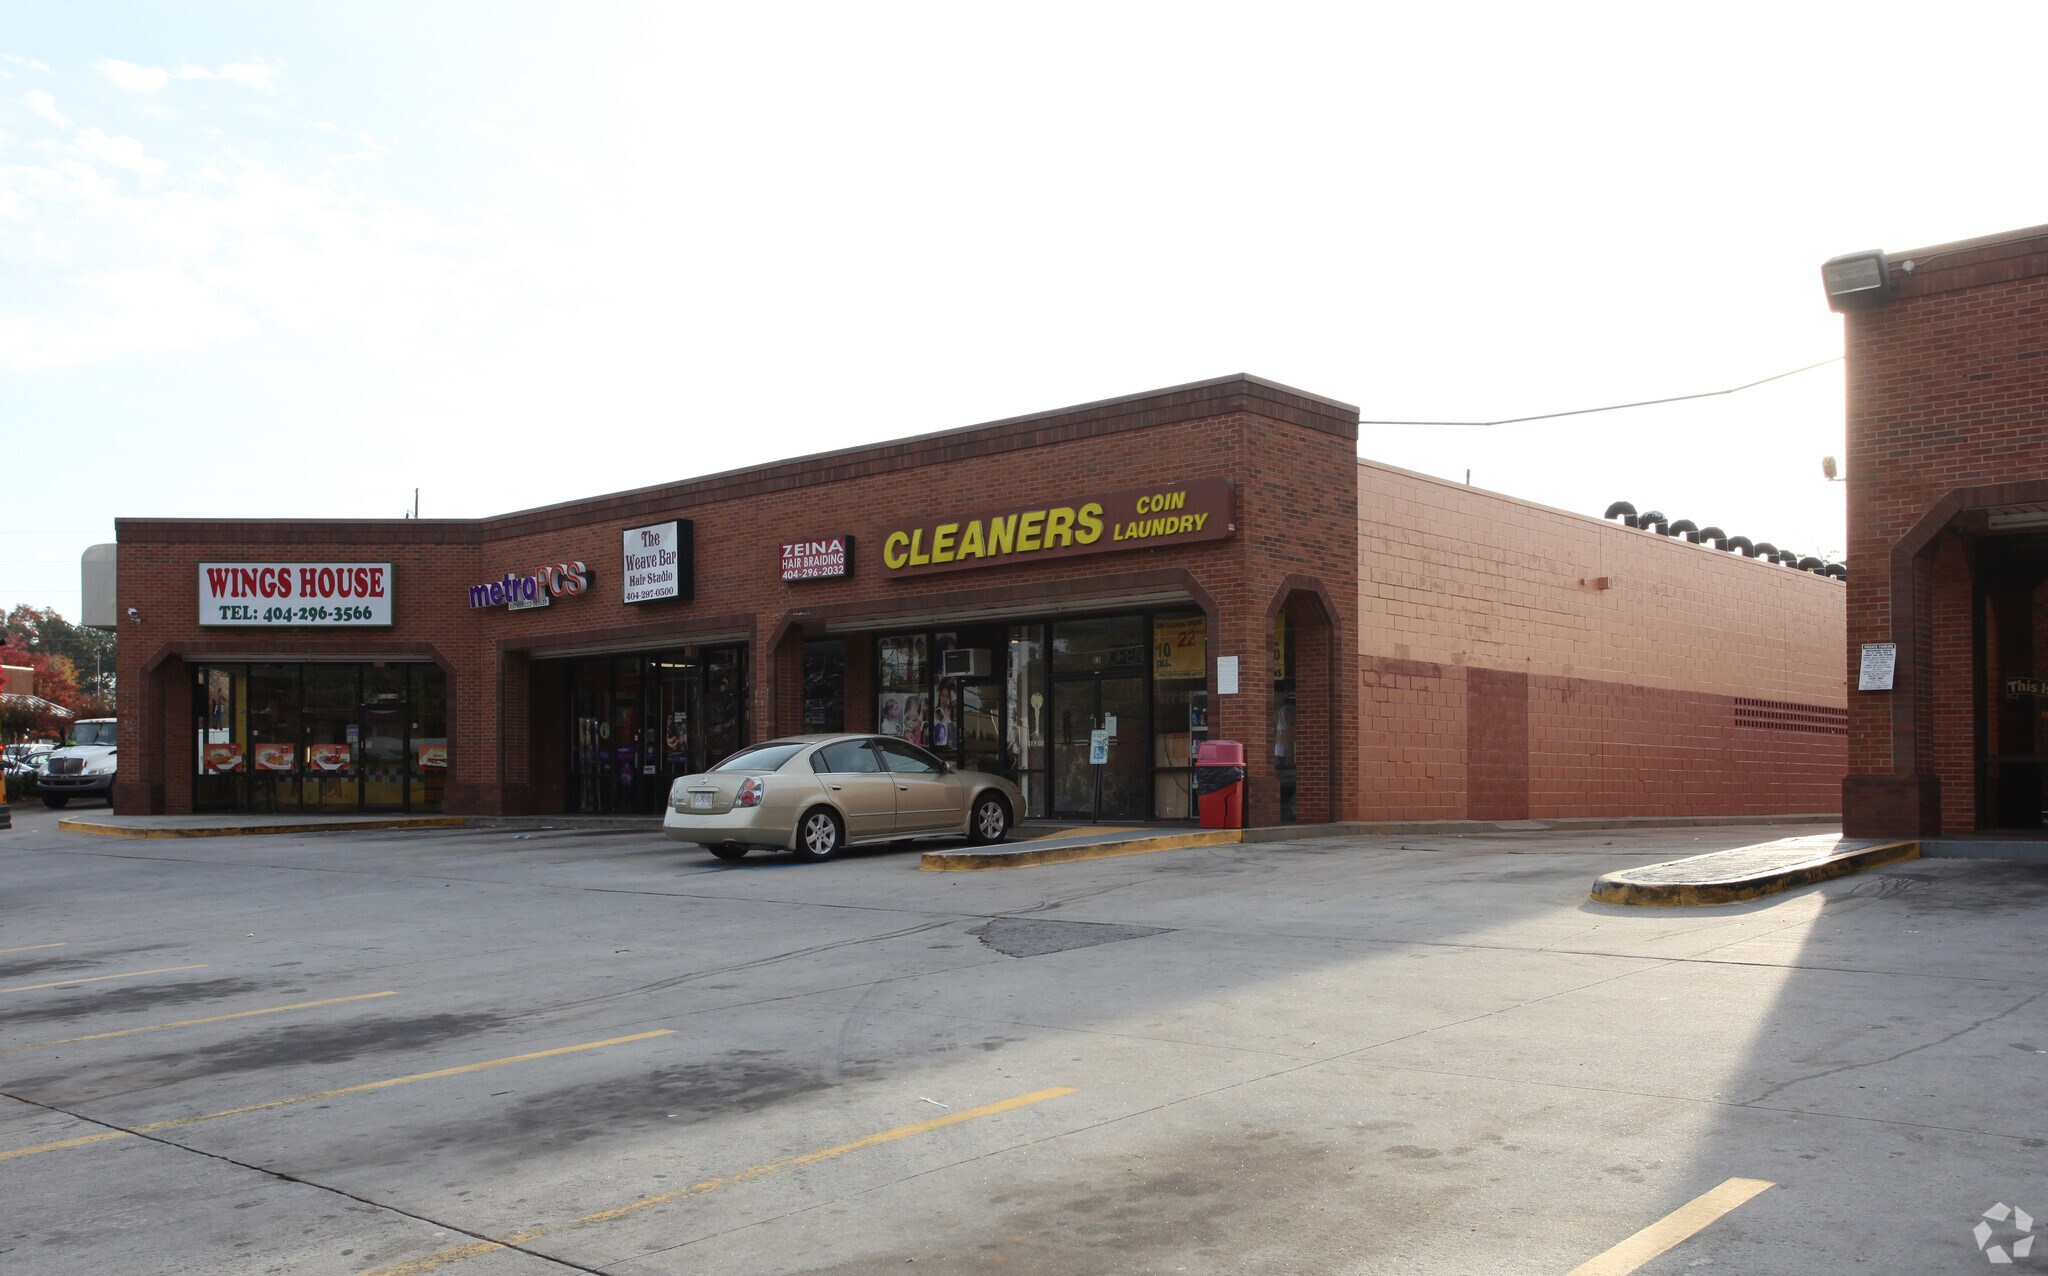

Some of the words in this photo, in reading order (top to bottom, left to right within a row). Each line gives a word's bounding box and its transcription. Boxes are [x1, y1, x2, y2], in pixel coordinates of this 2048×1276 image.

[1136, 490, 1187, 515] COIN
[1113, 512, 1209, 541] LAUNDRY
[641, 530, 660, 547] The
[883, 502, 1104, 570] CLEANERS
[782, 539, 843, 558] ZEINA
[626, 554, 657, 571] Weave
[659, 549, 676, 566] Bar
[782, 558, 801, 569] HAIR
[804, 553, 844, 568] BRAIDING
[629, 574, 646, 587] Hair
[647, 570, 673, 584] Studio
[782, 565, 844, 579] 404-296-2032
[207, 567, 292, 598] WINGS
[299, 567, 384, 598] HOUSE
[469, 561, 586, 608] metroPCS
[219, 605, 258, 620] TEL:
[263, 605, 372, 622] 404-296-3566
[1109, 648, 1144, 665] OPEN
[1155, 642, 1171, 658] 10
[2007, 679, 2038, 693] This
